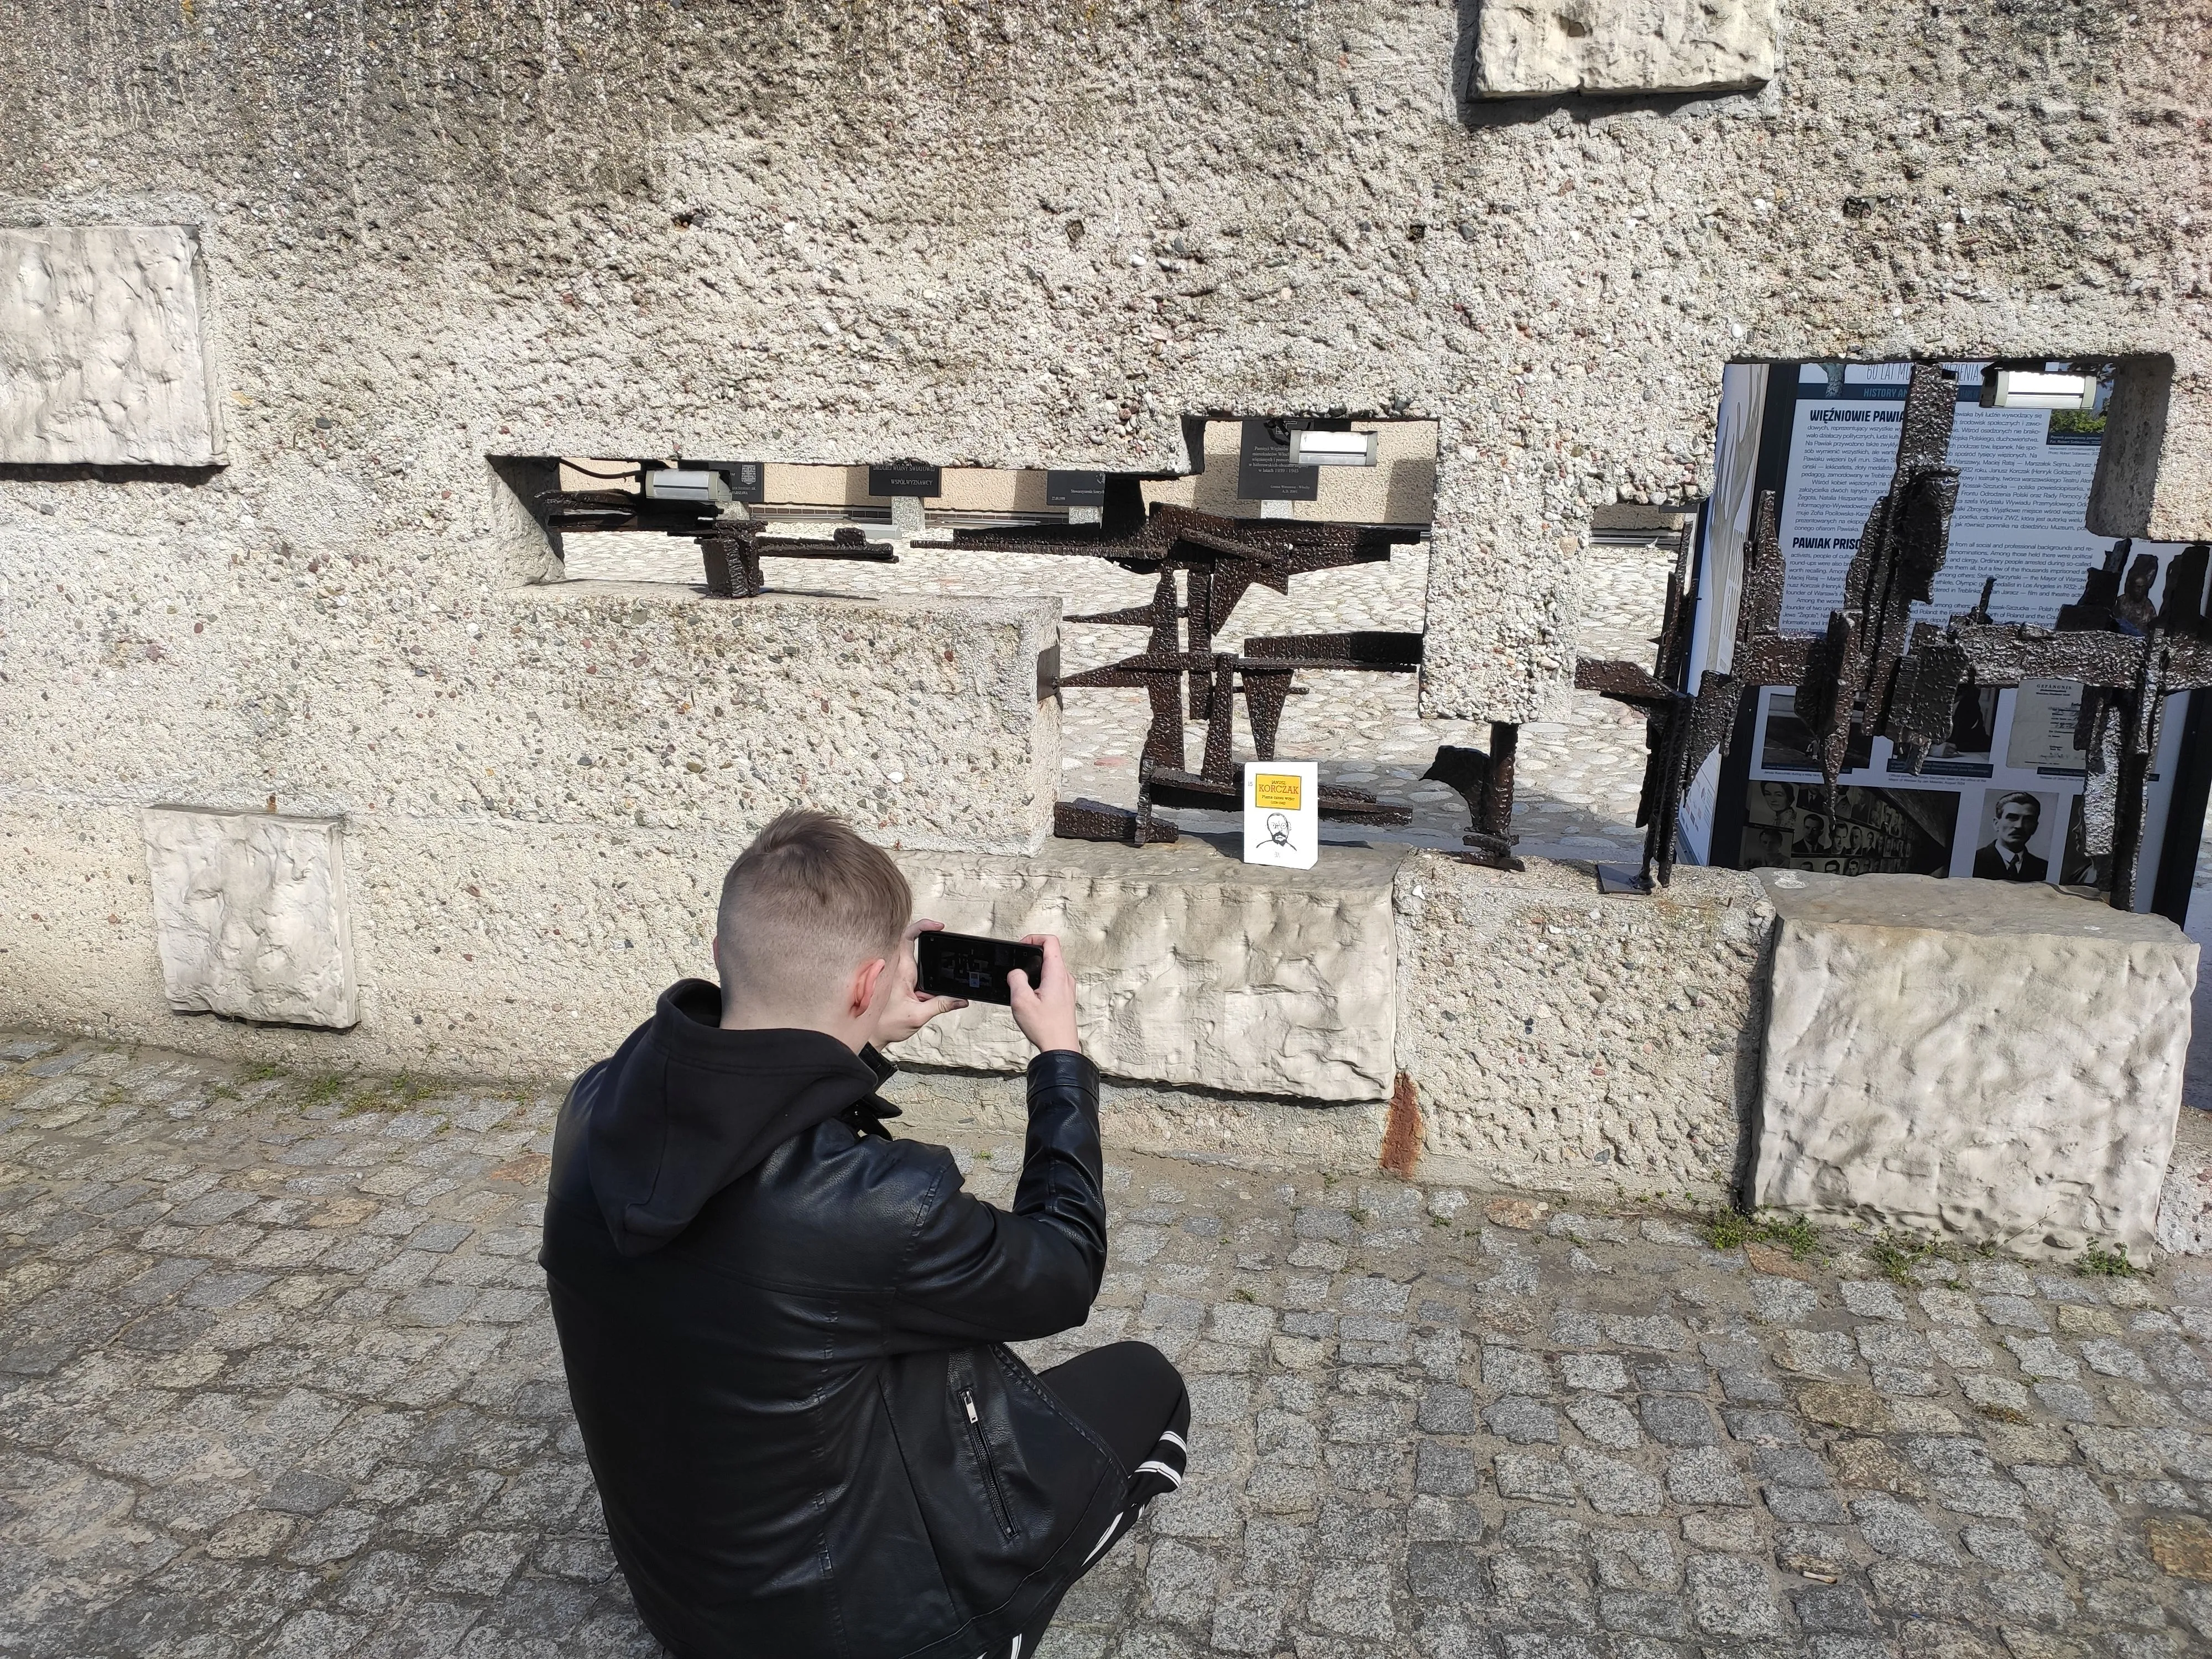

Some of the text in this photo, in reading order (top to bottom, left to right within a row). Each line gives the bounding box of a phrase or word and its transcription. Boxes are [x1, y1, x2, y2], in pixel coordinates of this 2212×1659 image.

[1867, 364, 1877, 379] 60
[1881, 364, 1894, 380] LAT
[1864, 388, 1896, 398] HISTORY
[1810, 408, 1903, 424] WIĘŹNIOWIE PAWIA
[1792, 538, 1861, 549] PAWIAK PRISO
[1259, 784, 1298, 794] KORCZAK
